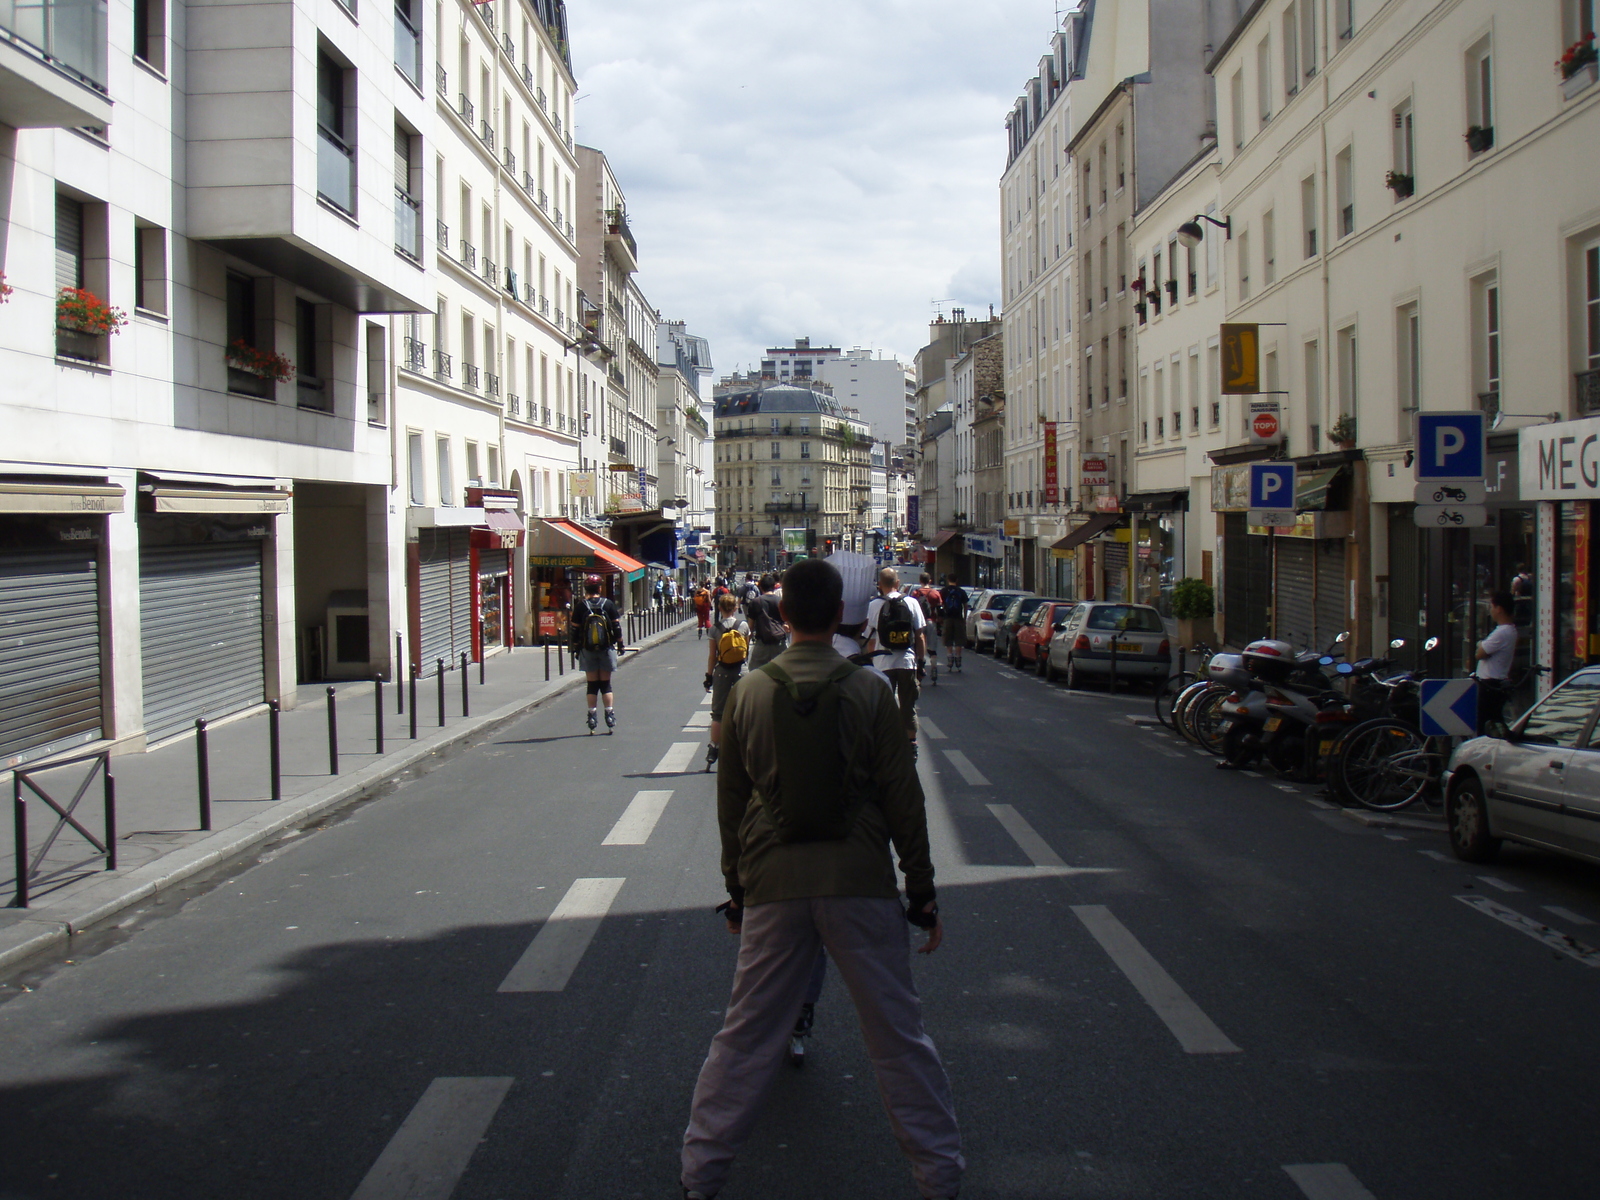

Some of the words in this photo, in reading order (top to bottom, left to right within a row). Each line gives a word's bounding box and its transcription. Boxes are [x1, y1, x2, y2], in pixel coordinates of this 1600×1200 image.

[1254, 422, 1277, 430] TOPY
[1435, 425, 1465, 467] P
[1538, 434, 1599, 491] MEG
[1083, 477, 1106, 485] BAR
[1261, 472, 1282, 501] P
[529, 557, 549, 566] FRUITS
[550, 558, 557, 566] et
[889, 630, 910, 644] CAT
